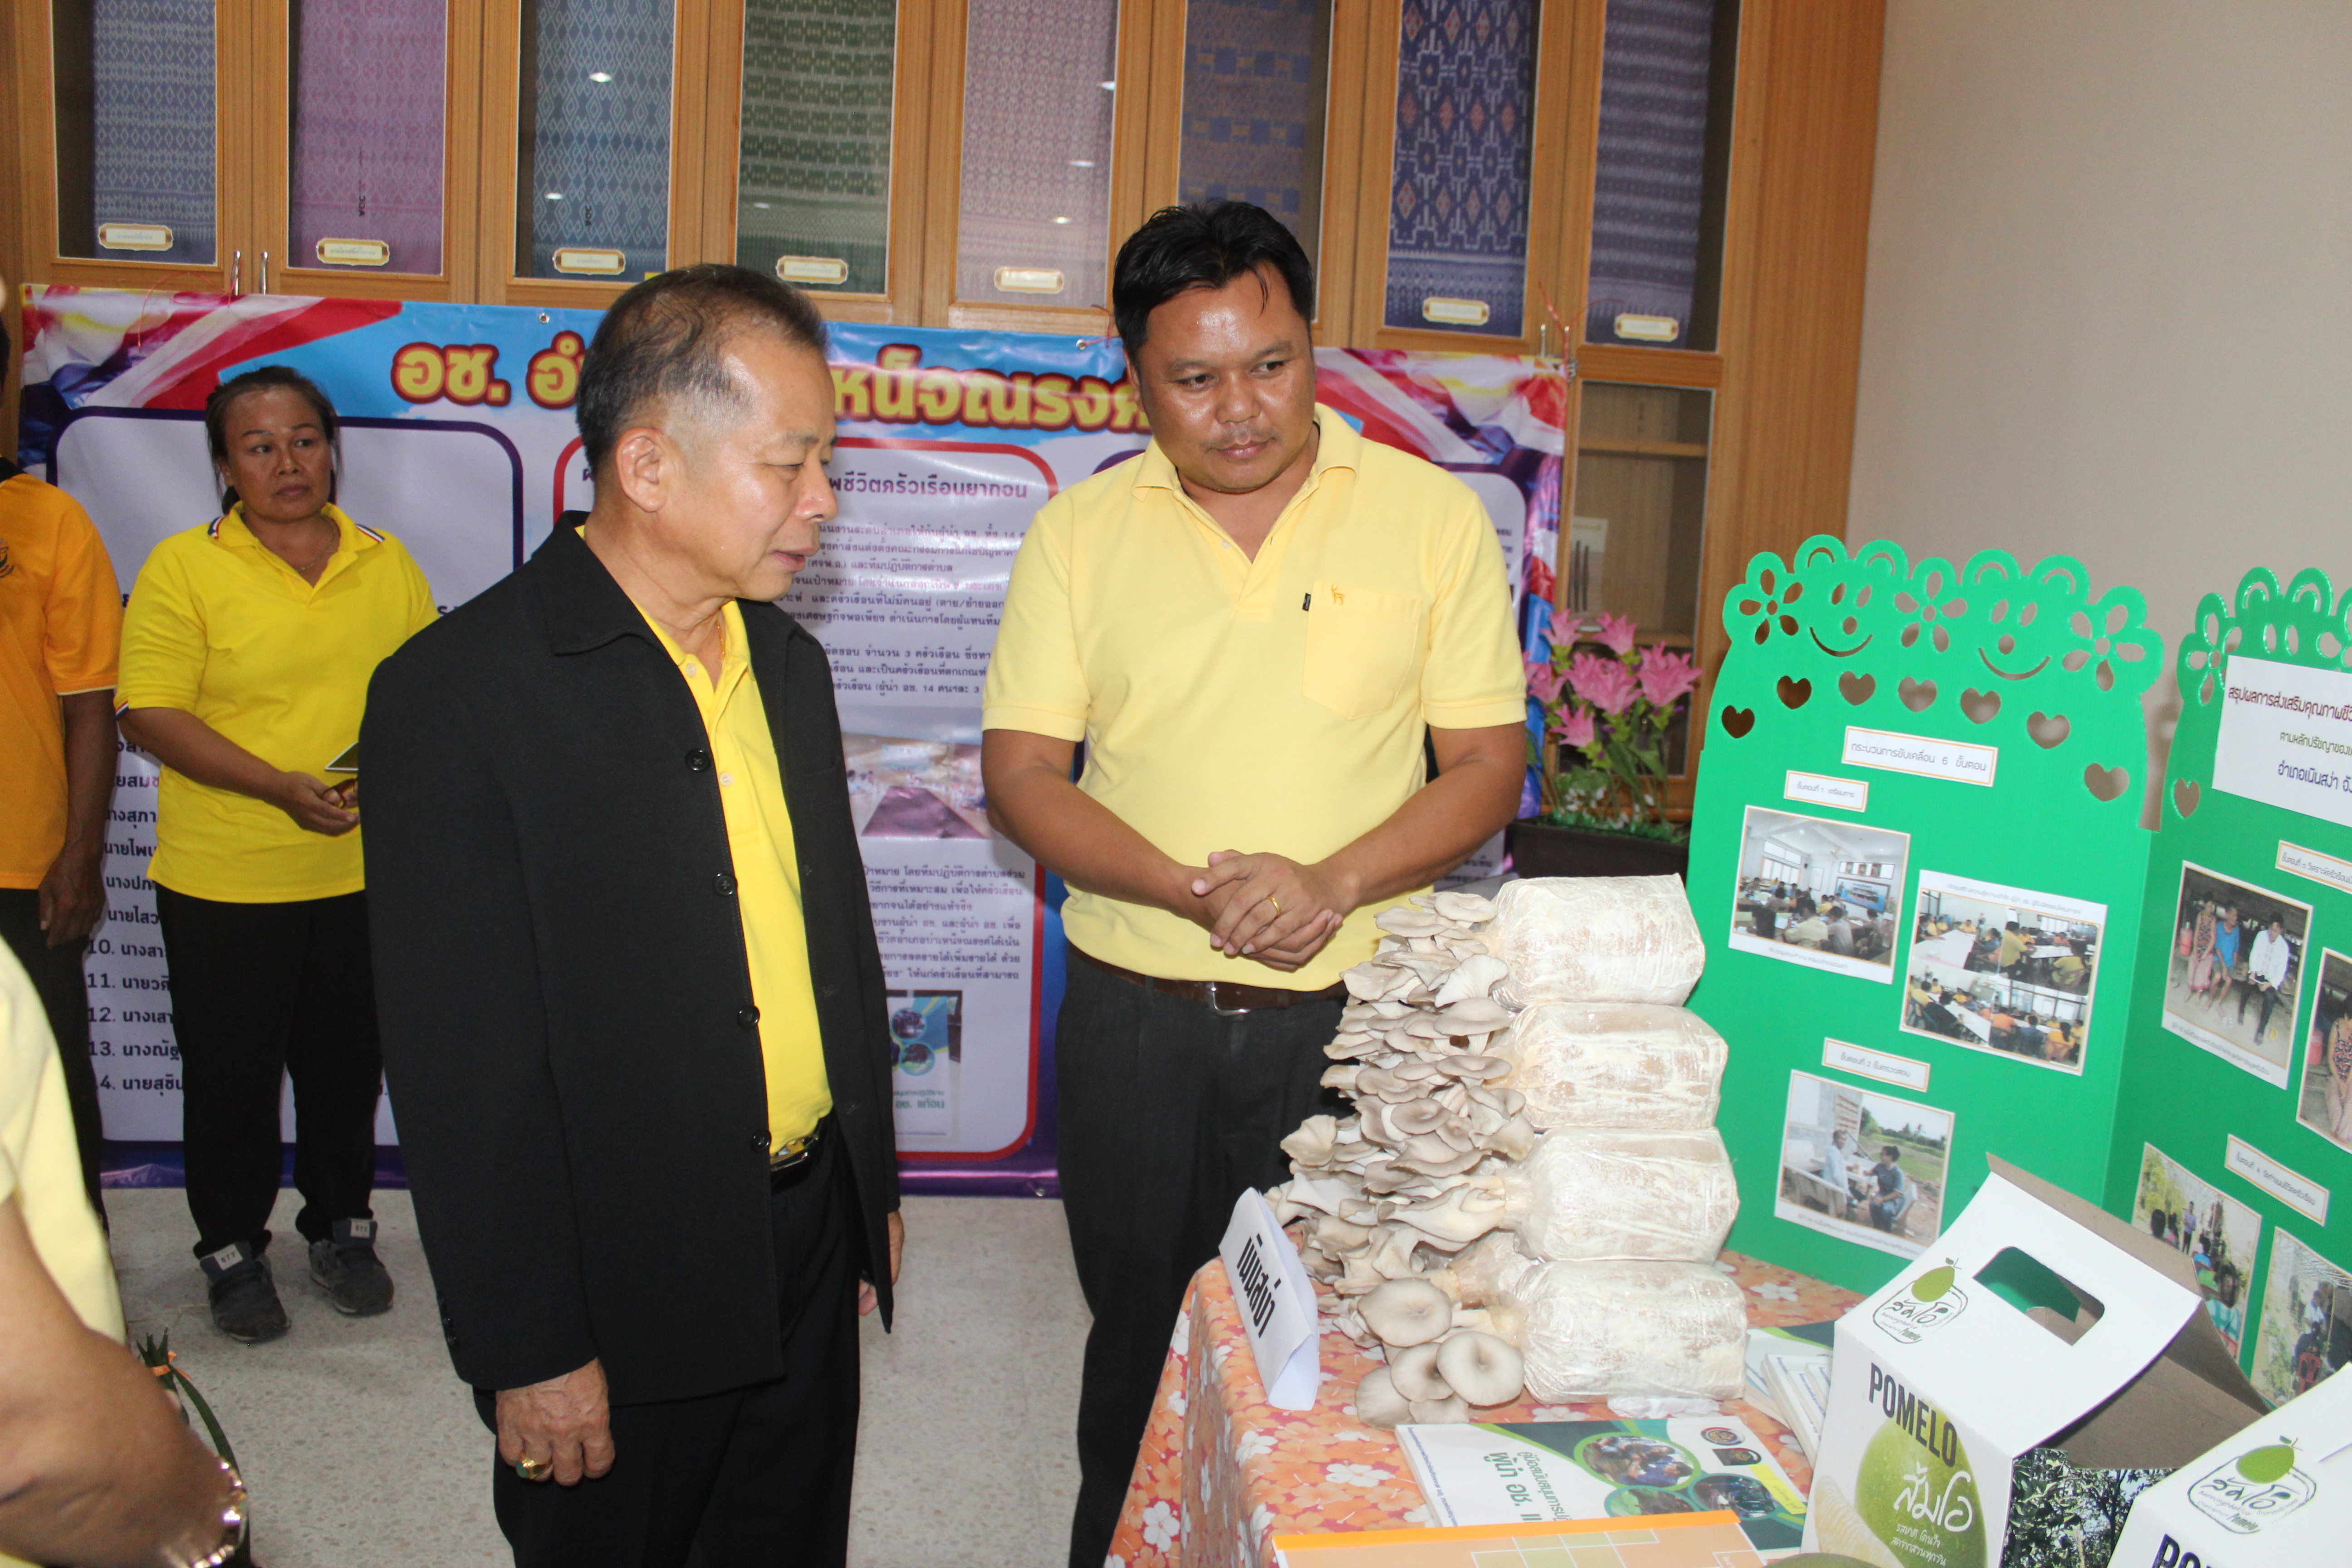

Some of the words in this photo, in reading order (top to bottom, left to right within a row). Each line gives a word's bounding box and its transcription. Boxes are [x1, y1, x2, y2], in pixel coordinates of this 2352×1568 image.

[391, 341, 512, 407] อช.
[1942, 757, 1948, 765] 6
[88, 973, 116, 989] 11.
[99, 1074, 116, 1090] 4.
[1868, 1362, 1957, 1468] POMELO
